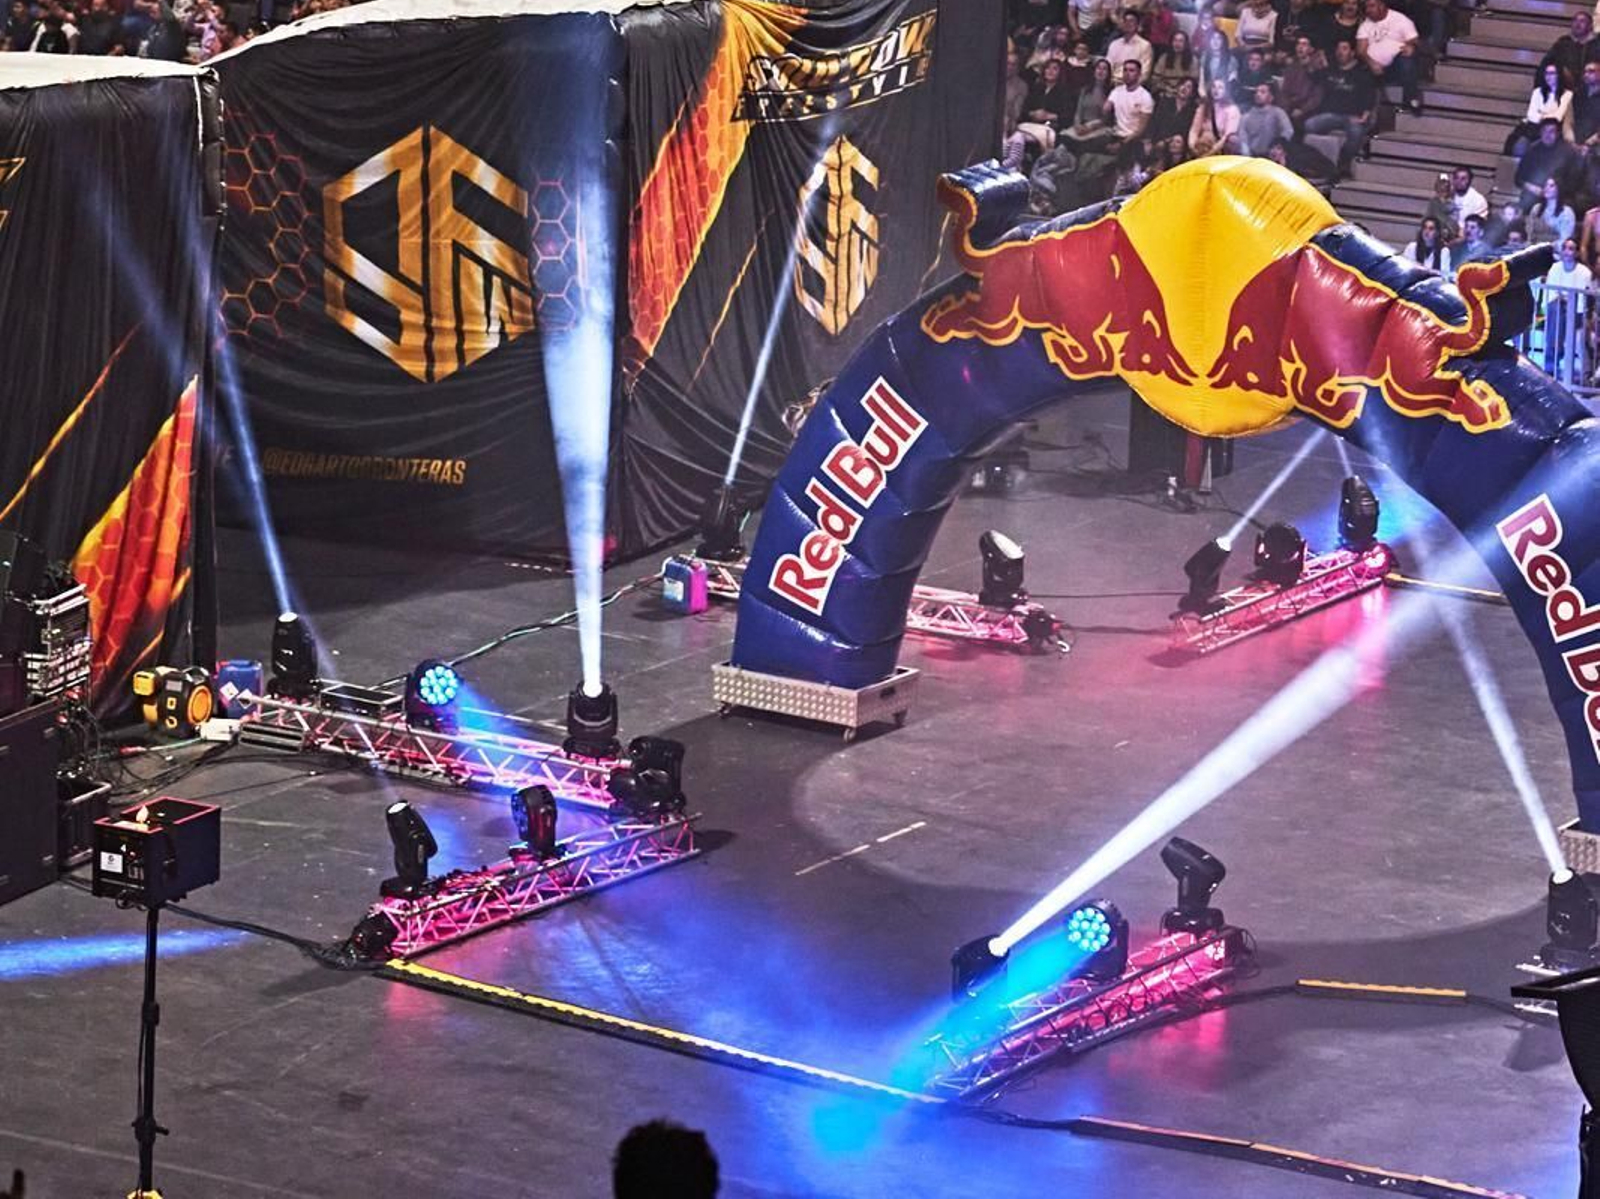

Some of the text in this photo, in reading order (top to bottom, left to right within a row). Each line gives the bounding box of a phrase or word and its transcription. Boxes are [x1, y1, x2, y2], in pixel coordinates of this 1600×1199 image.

[769, 479, 862, 613] Red
[822, 377, 927, 507] Bull
[1497, 494, 1600, 641] Red
